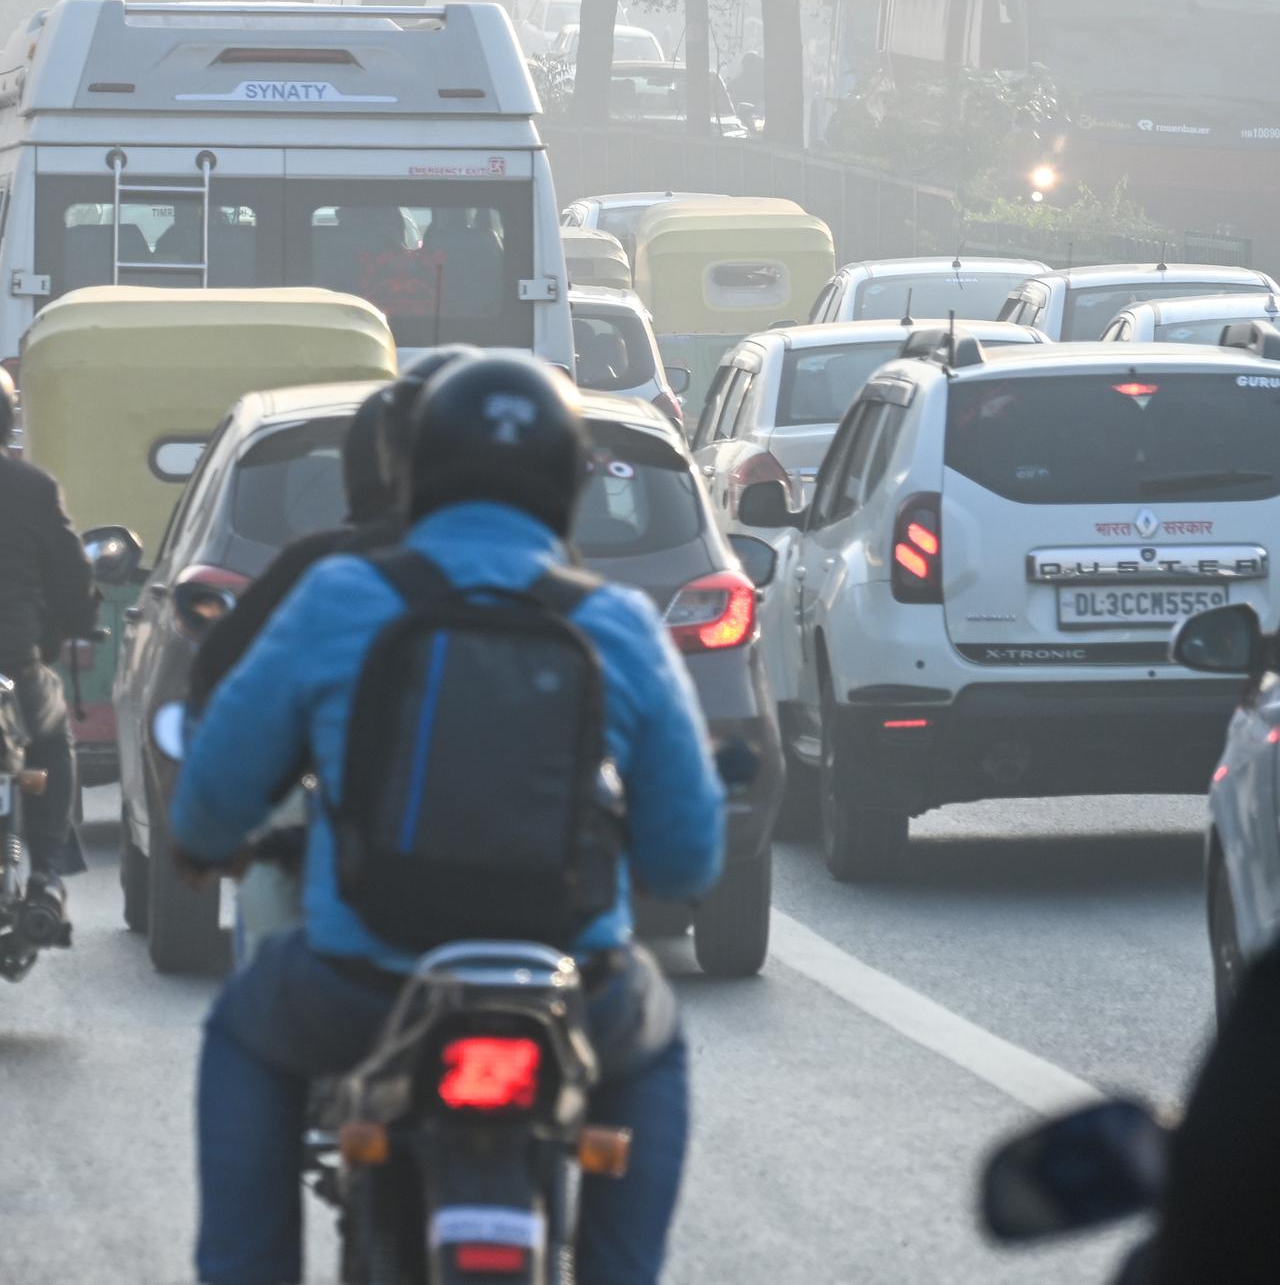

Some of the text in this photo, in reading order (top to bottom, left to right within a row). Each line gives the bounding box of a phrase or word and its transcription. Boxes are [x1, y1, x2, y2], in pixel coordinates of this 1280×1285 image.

[244, 83, 328, 101] SYNATY
[1095, 520, 1214, 536] भारत सरकार
[1040, 558, 1258, 576] DUSTER
[986, 648, 1087, 660] X-TRONIC
